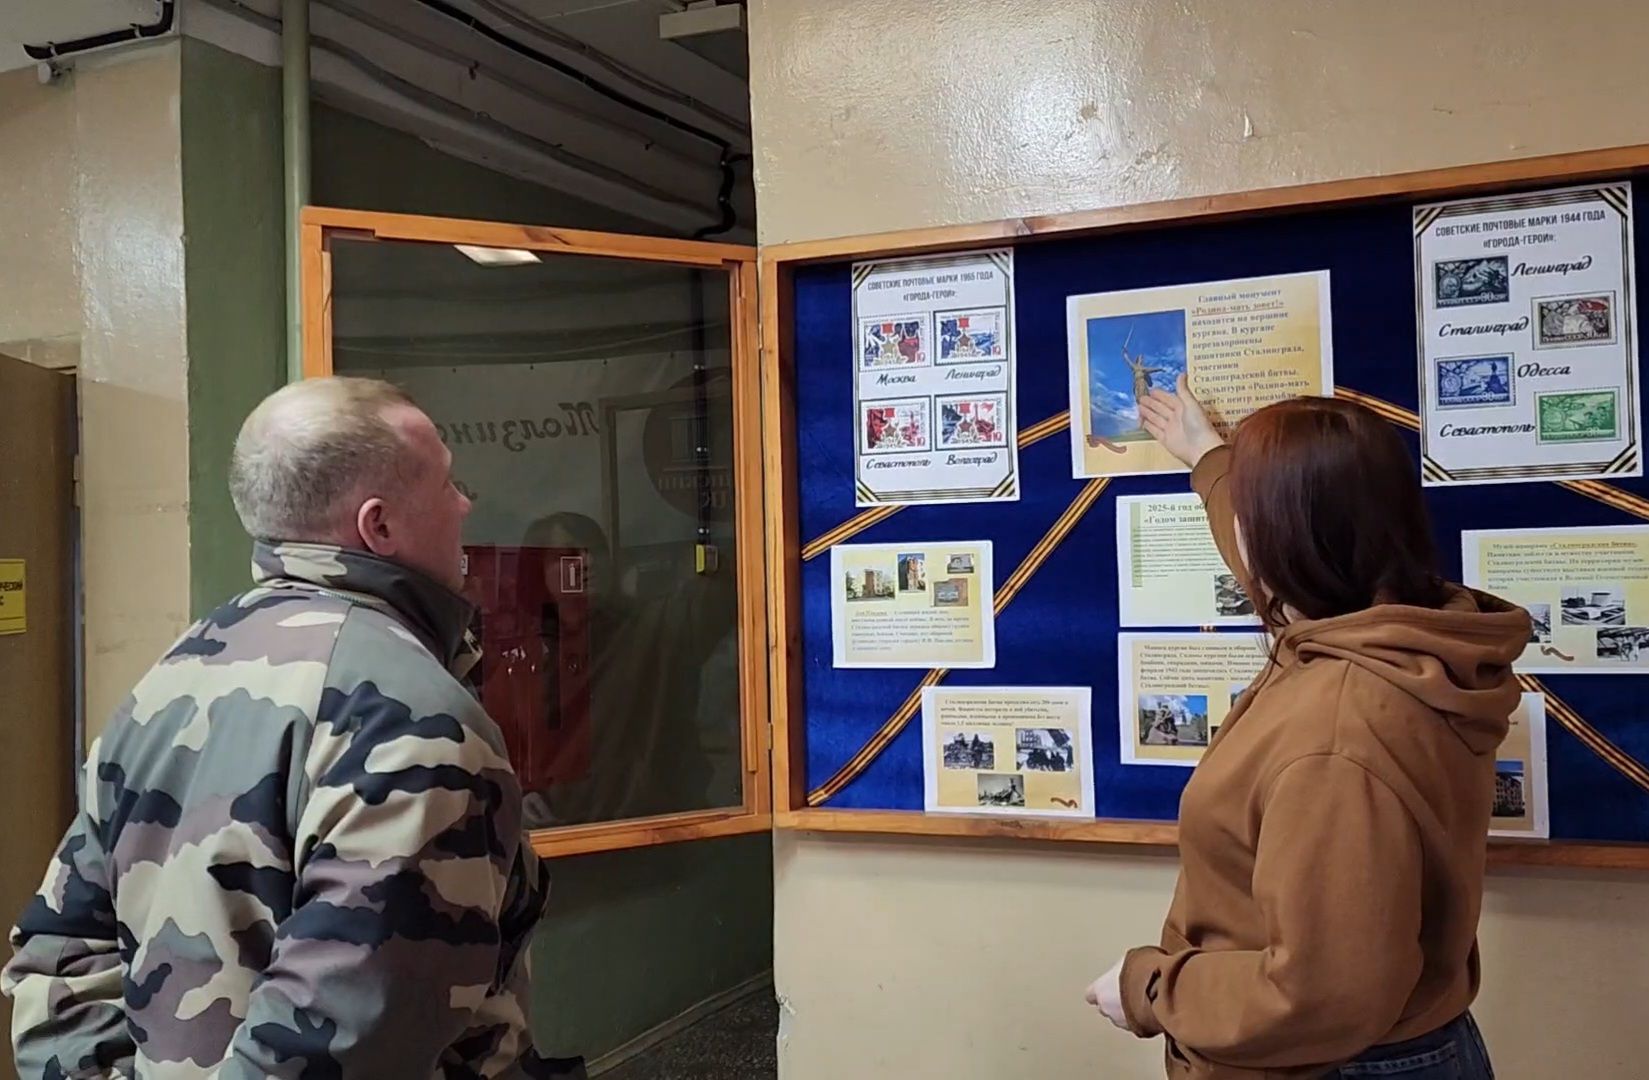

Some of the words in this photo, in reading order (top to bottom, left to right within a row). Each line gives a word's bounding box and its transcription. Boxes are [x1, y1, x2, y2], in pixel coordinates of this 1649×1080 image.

[1435, 223, 1481, 237] СОВЕТСКИЕ
[1482, 218, 1527, 232] ПОЧТОВЫЕ
[1528, 214, 1558, 228] МАРКИ
[1560, 213, 1582, 224] 1944
[1583, 210, 1606, 222] ГОДА
[1511, 256, 1592, 277] Ленинград
[867, 279, 901, 290] СОВЕТСКИЕ
[902, 276, 935, 287] ПОЧТОВЫЕ
[936, 274, 958, 284] МАРКИ
[976, 270, 993, 280] ГОДА
[1198, 293, 1237, 304] Главный
[1239, 289, 1282, 300] монумент
[1439, 316, 1529, 337] Сталинград
[945, 365, 1001, 380] Ленинград
[1517, 363, 1571, 378] Одесса
[876, 373, 916, 386] Москва
[1440, 423, 1536, 438] Севастополь
[866, 458, 931, 470] Севастополь
[945, 451, 998, 467] Волгоград
[1147, 504, 1175, 512] 2025-й
[1177, 504, 1192, 512] год
